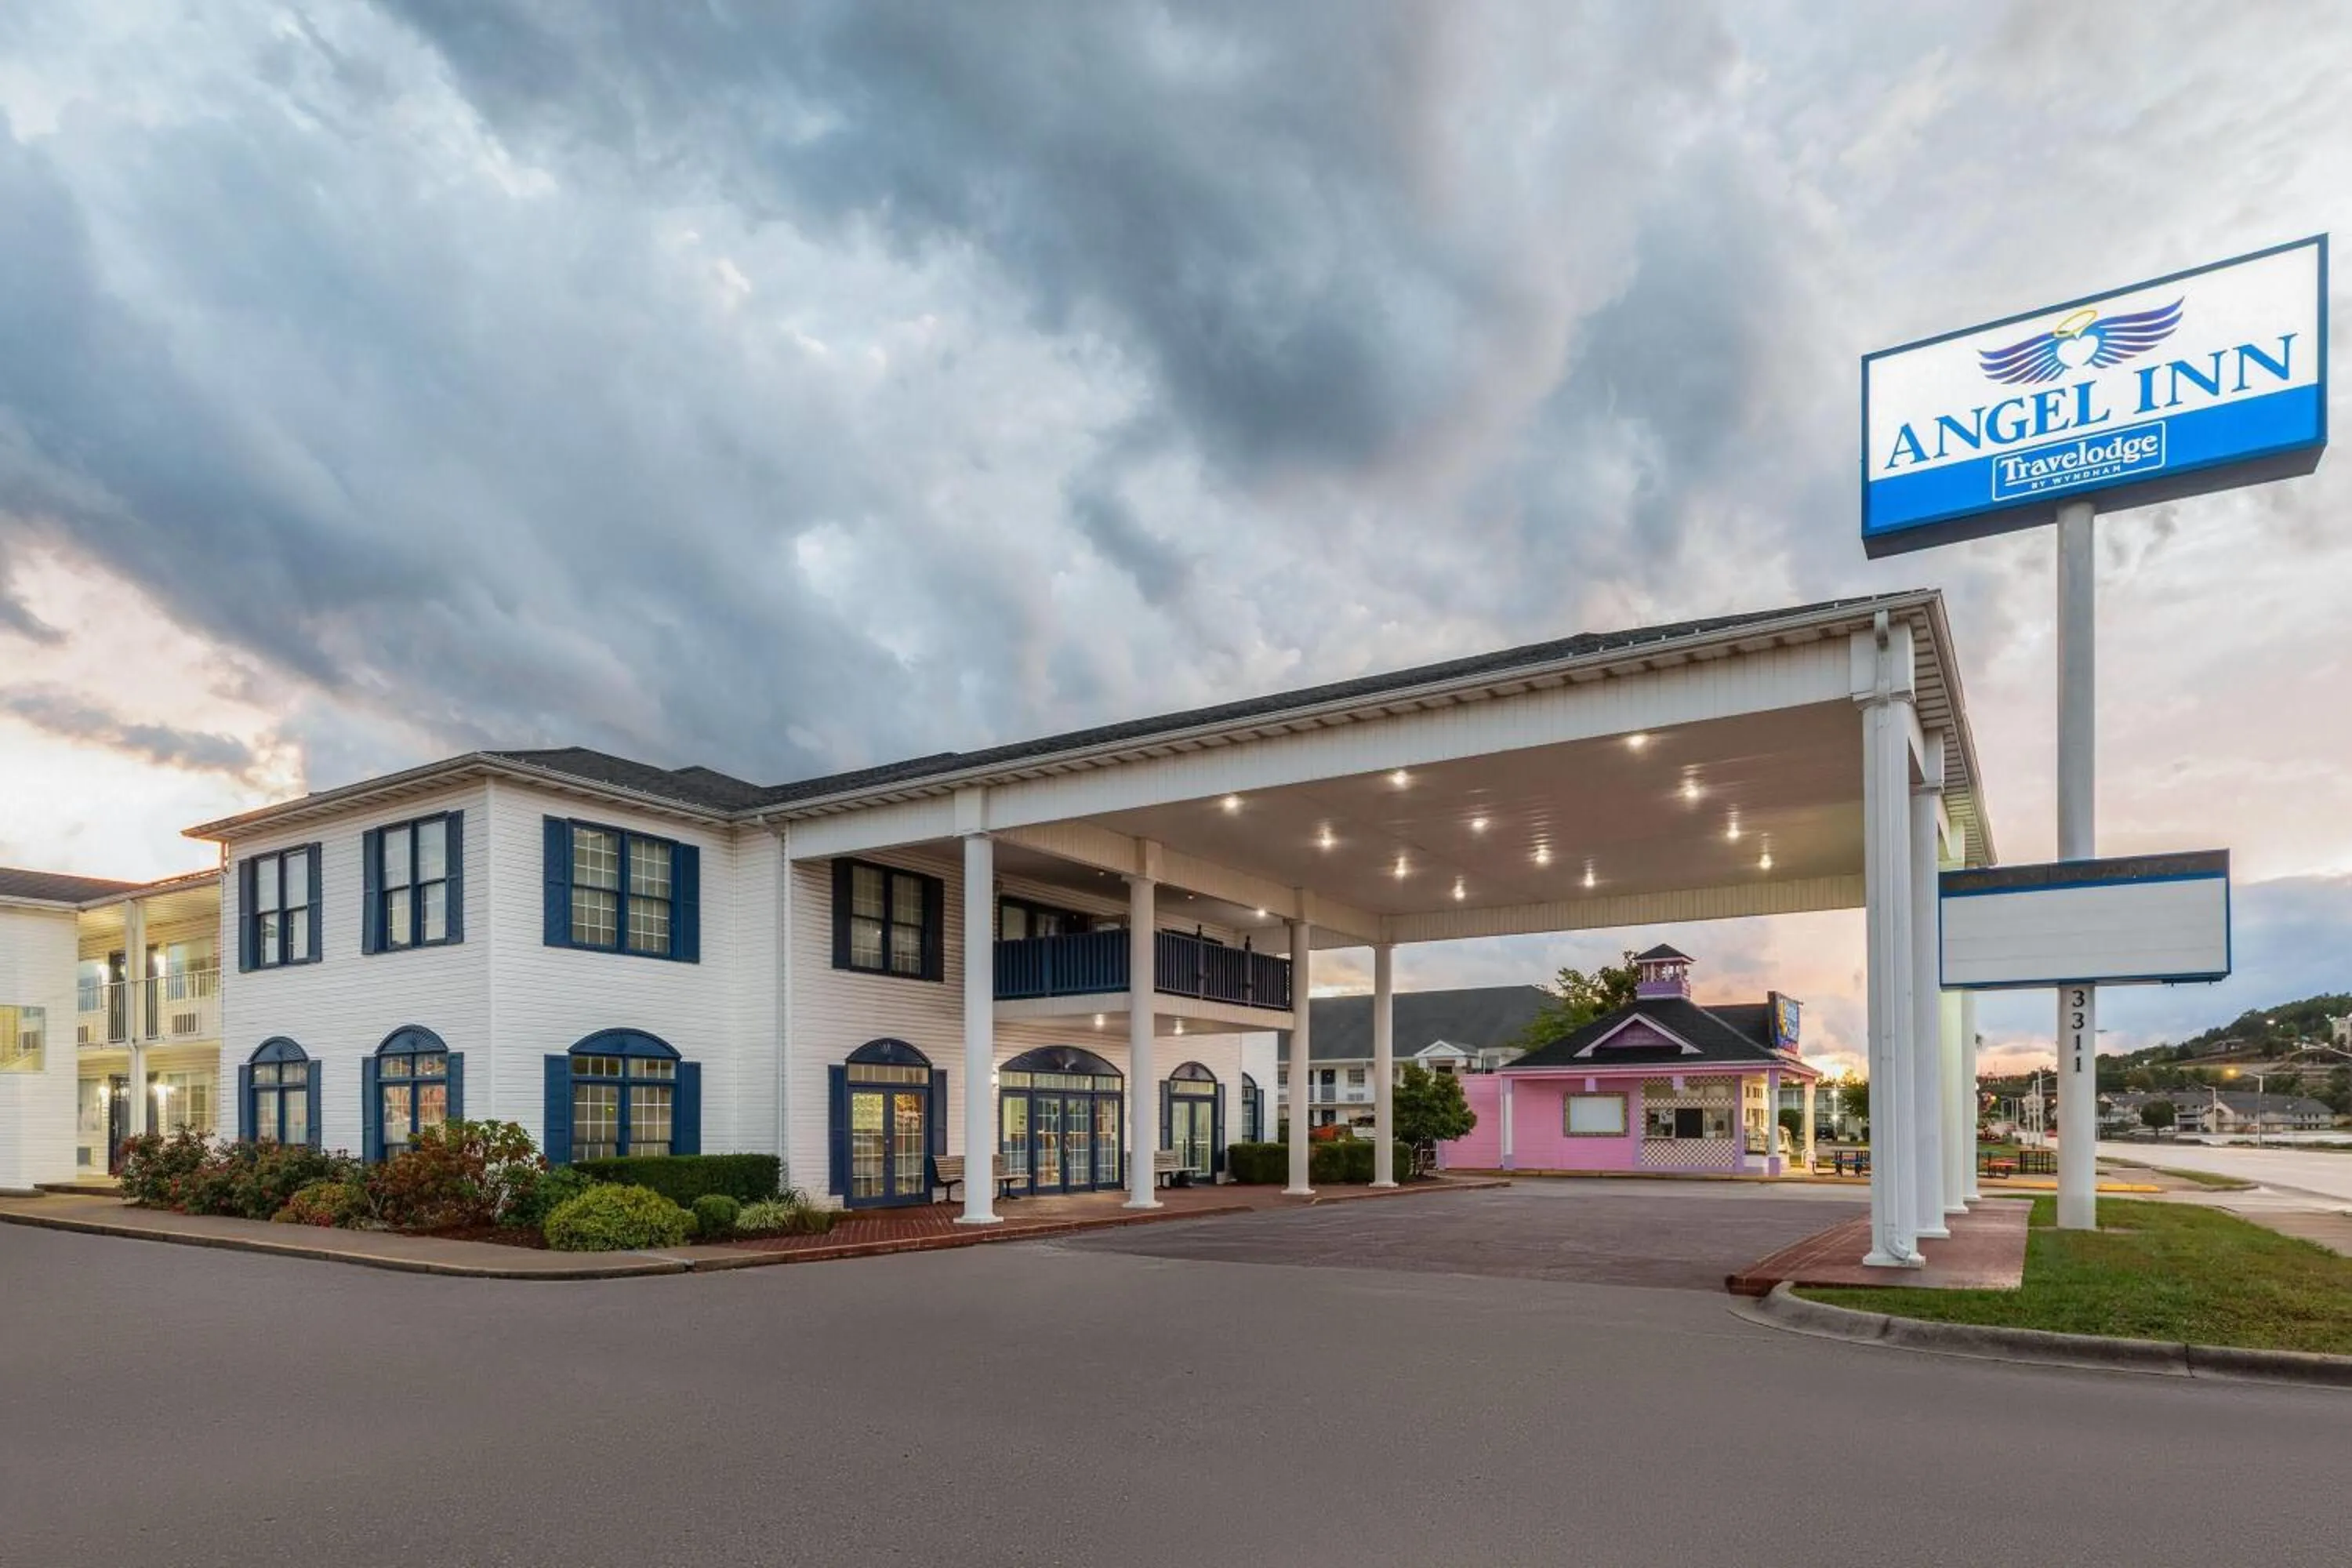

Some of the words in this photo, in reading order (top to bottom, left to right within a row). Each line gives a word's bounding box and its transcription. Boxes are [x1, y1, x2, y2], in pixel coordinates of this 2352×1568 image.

[1885, 380, 2109, 469] ANGEL
[2134, 333, 2298, 414] INN
[2000, 435, 2158, 481] Travelodge
[2031, 480, 2045, 489] BY
[2052, 465, 2121, 485] WYNDHAM
[2071, 989, 2085, 1073] 3311
